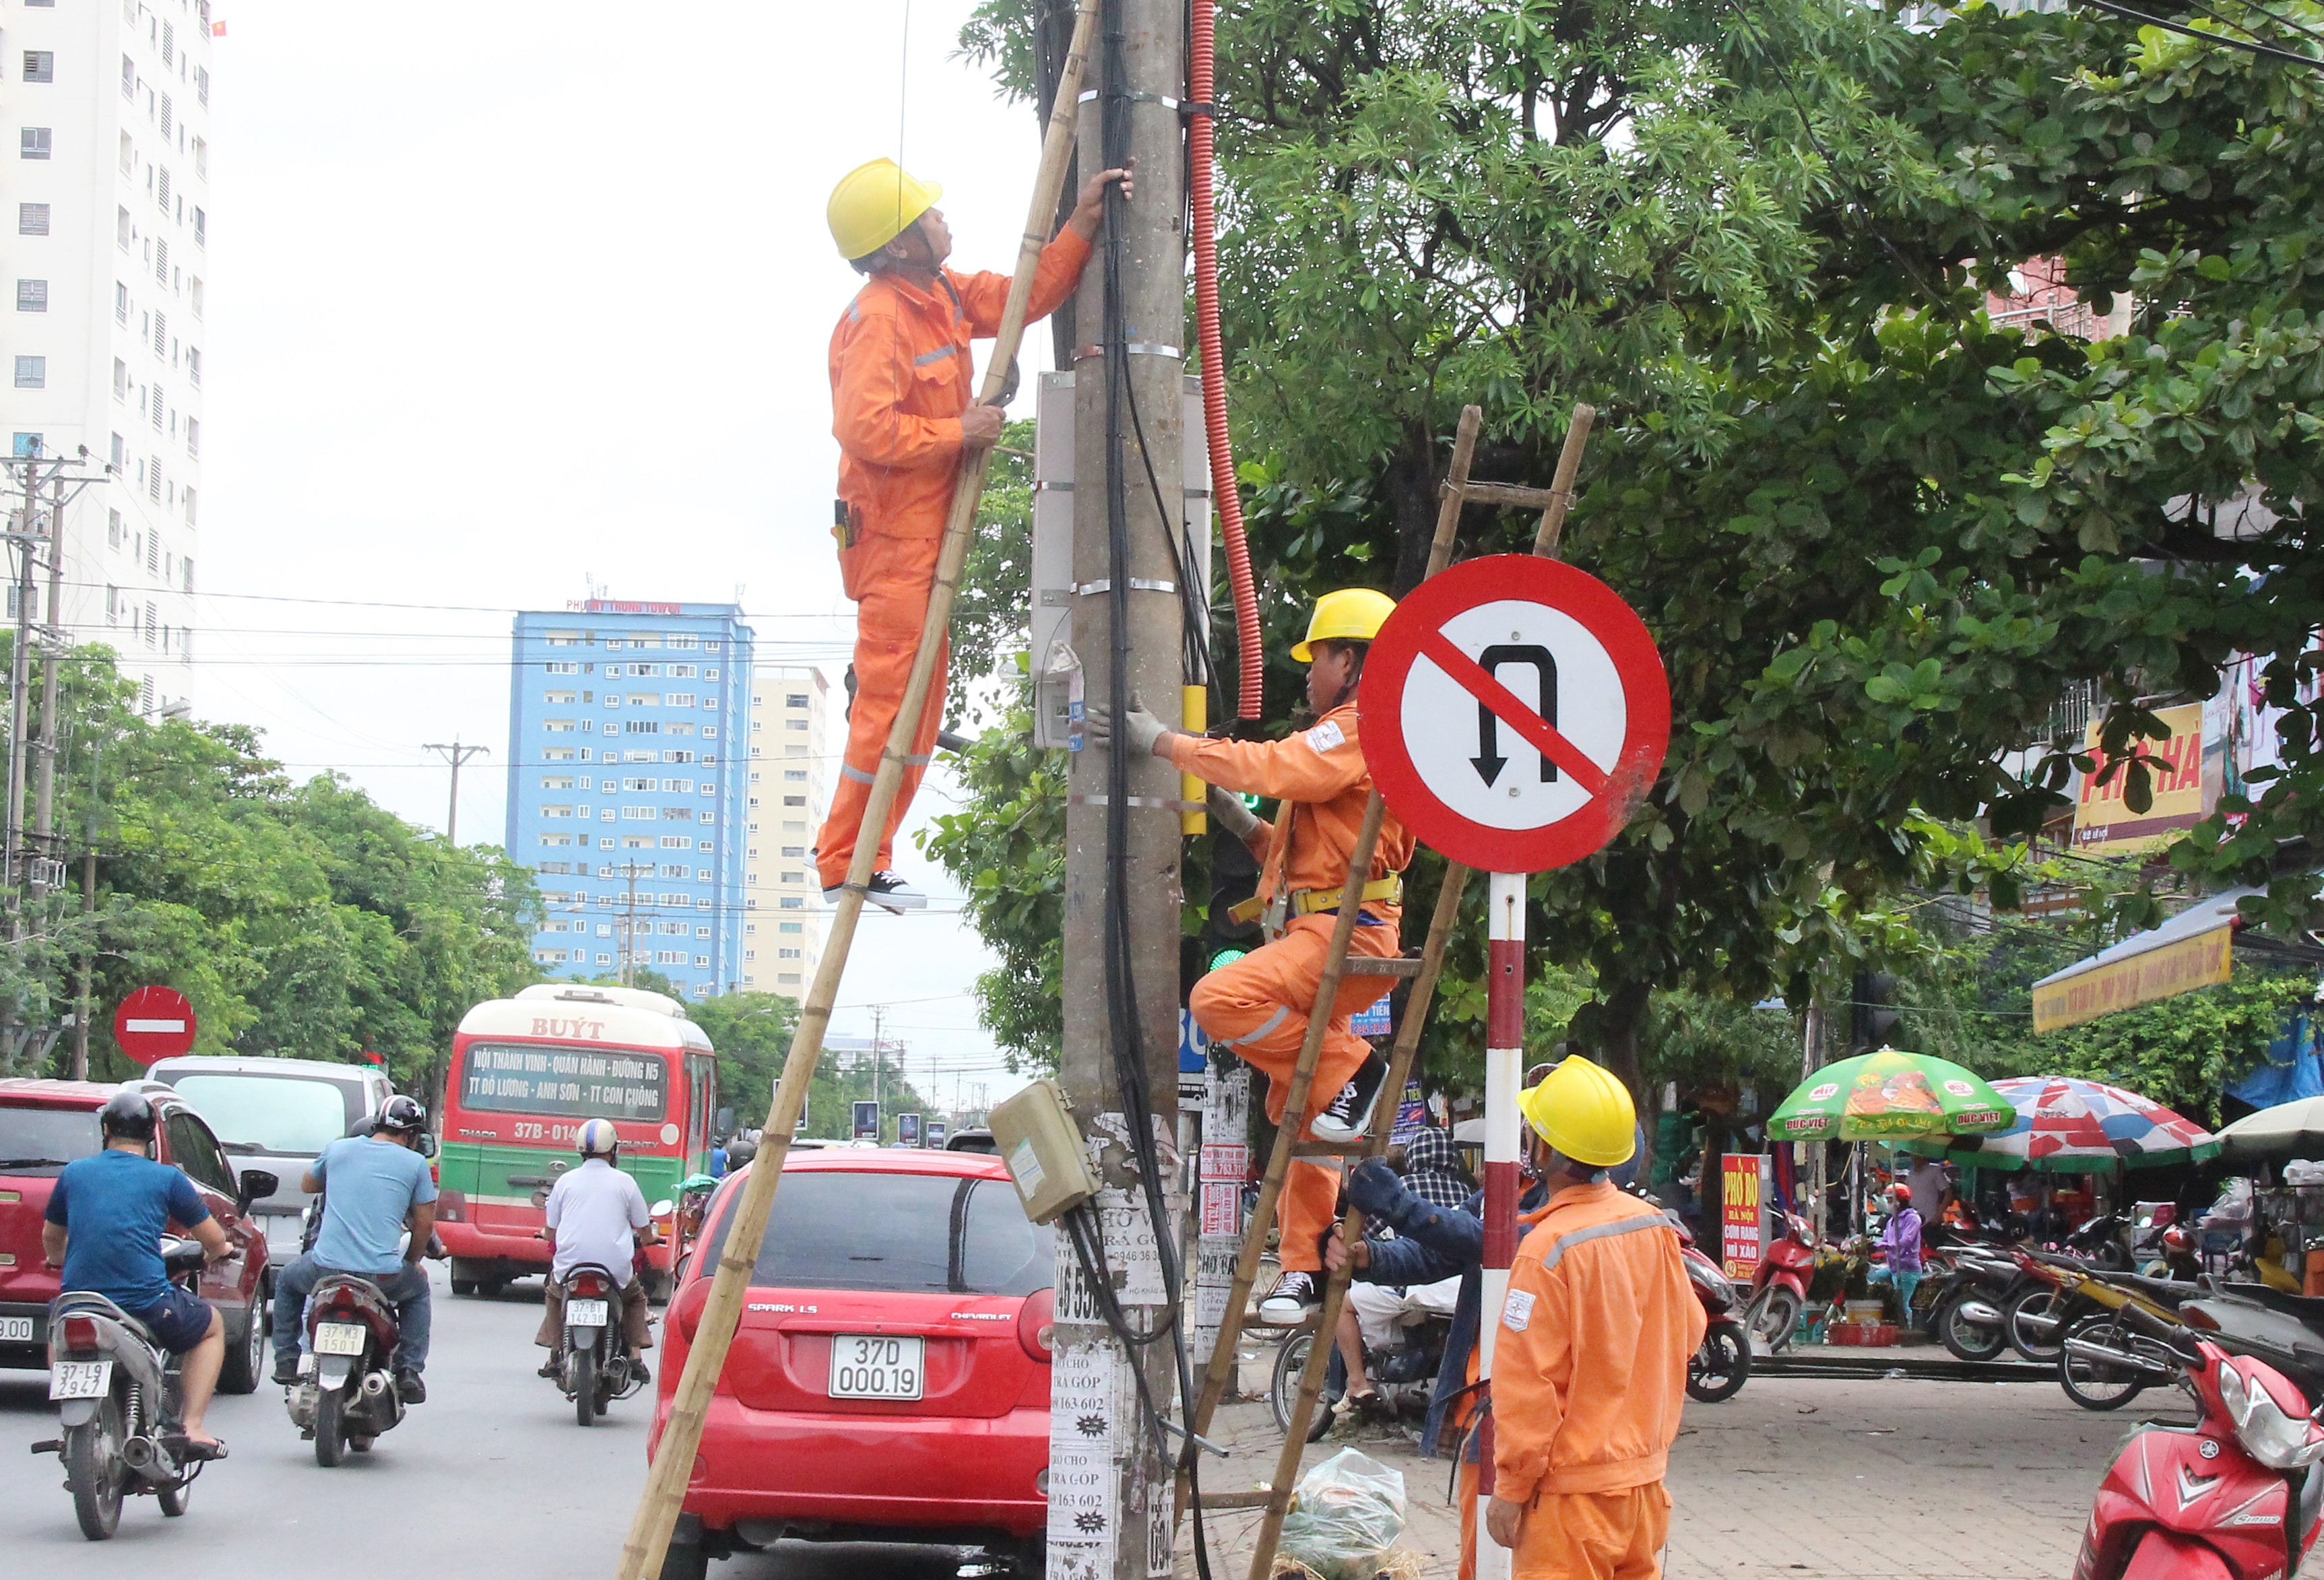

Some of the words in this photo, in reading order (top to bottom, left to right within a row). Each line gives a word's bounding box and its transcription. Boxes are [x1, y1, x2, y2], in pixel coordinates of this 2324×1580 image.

[531, 1017, 606, 1040] BUÝT
[474, 1048, 490, 1072] NỘI
[493, 1049, 523, 1071] THÀNH
[525, 1053, 547, 1072] VINH
[552, 1053, 579, 1076] QUÁN
[580, 1055, 606, 1076] HÀNH
[645, 1061, 659, 1080] N5
[469, 1076, 480, 1095] TT
[497, 1078, 529, 1098] LƯƠNG
[536, 1081, 557, 1100] ANH
[559, 1082, 580, 1102] SƠN
[591, 1085, 601, 1102] TT
[603, 1086, 624, 1105] CON
[625, 1085, 659, 1107] CUÔNG
[1724, 1158, 1743, 1206] PHỞ
[1745, 1162, 1758, 1208] BÒ
[1729, 1208, 1739, 1220] HÀ
[1741, 1210, 1754, 1223] NỘI
[1726, 1242, 1738, 1257] MÌ
[1739, 1243, 1757, 1259] XÀO
[748, 1303, 795, 1313] SPARK
[799, 1305, 818, 1314] LS
[951, 1312, 1012, 1321] CHEVROLET
[324, 1339, 355, 1353] 1501
[855, 1339, 901, 1366] 37D
[1066, 1358, 1089, 1369] CHO
[61, 1364, 102, 1381] 37-L9
[839, 1367, 915, 1393] 000.19
[58, 1380, 100, 1396] 2947
[1071, 1374, 1101, 1388] GÓP
[1061, 1396, 1077, 1409] 163
[1080, 1396, 1103, 1410] 602
[1064, 1455, 1087, 1466] CHO
[1070, 1471, 1099, 1485] GÓP
[1059, 1494, 1075, 1507] 163
[1079, 1494, 1102, 1507] 602
